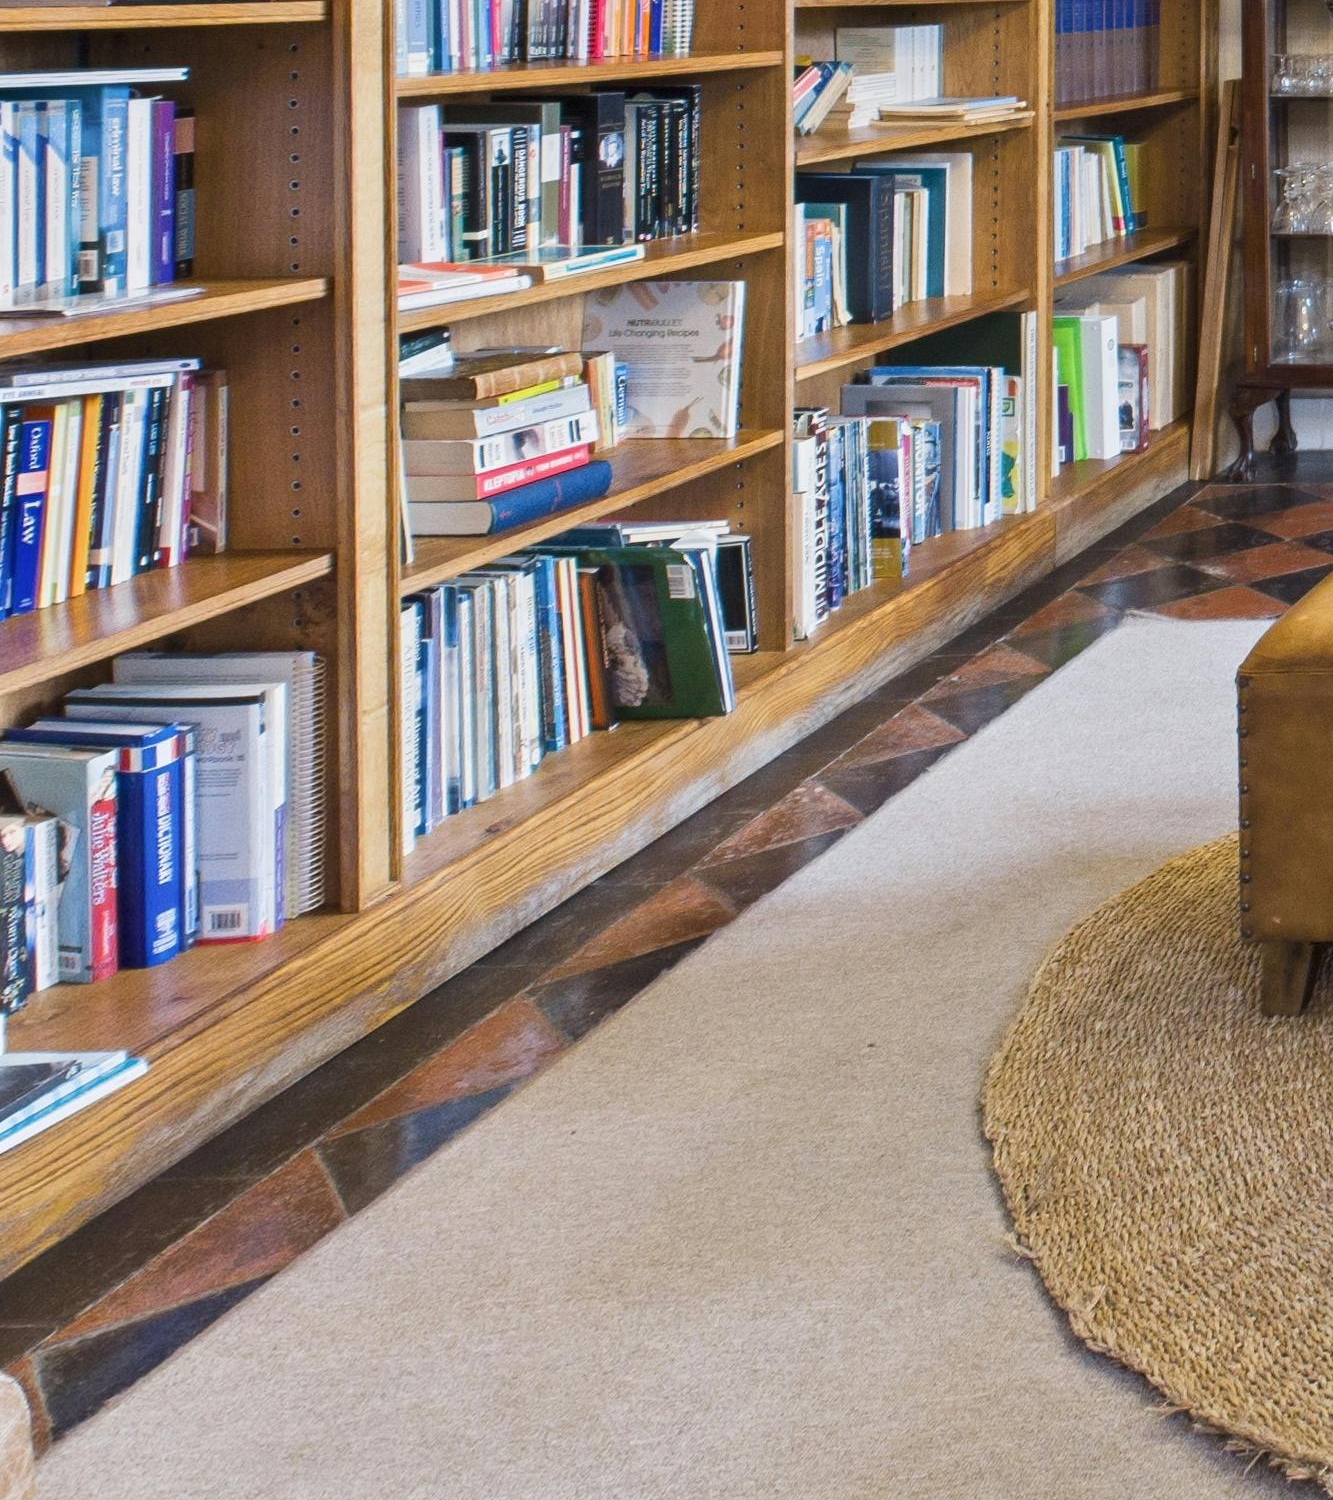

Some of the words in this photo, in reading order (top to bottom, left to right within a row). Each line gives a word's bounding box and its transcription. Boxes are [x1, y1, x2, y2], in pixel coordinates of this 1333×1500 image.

[111, 173, 123, 197] law
[518, 148, 528, 202] DANGEROUS
[518, 204, 528, 229] BOOK
[814, 245, 827, 288] Spain
[609, 329, 622, 338] Life
[624, 329, 666, 340] Changing
[667, 329, 700, 340] Recipes
[28, 427, 43, 470] Oxford
[814, 441, 831, 501] AGES
[914, 435, 926, 517] MONITOR
[22, 500, 42, 545] Law
[813, 508, 830, 595] MIDDLE
[414, 716, 424, 763] History
[91, 812, 110, 849] Julie
[157, 814, 173, 885] DICTIONARY
[91, 849, 109, 906] Walters
